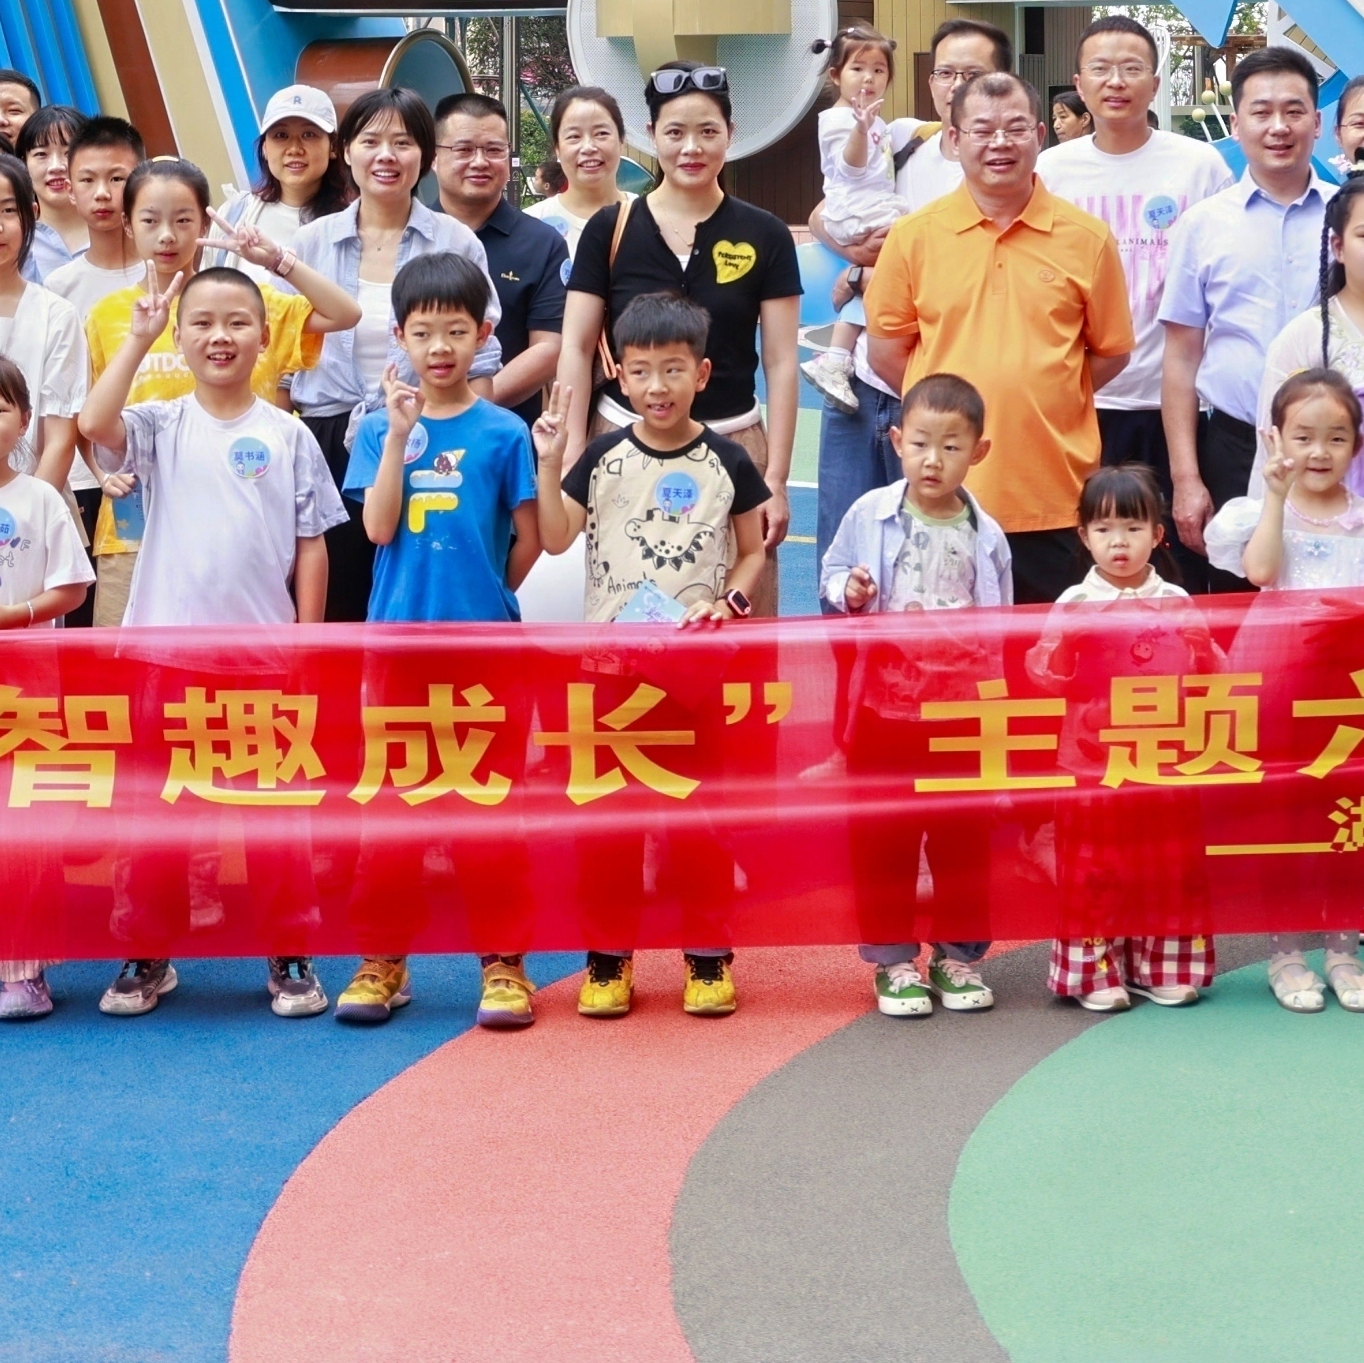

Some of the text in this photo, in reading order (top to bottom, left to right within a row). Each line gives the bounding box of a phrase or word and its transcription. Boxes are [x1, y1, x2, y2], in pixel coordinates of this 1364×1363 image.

[293, 95, 302, 105] R
[662, 487, 693, 499] 夏天泽
